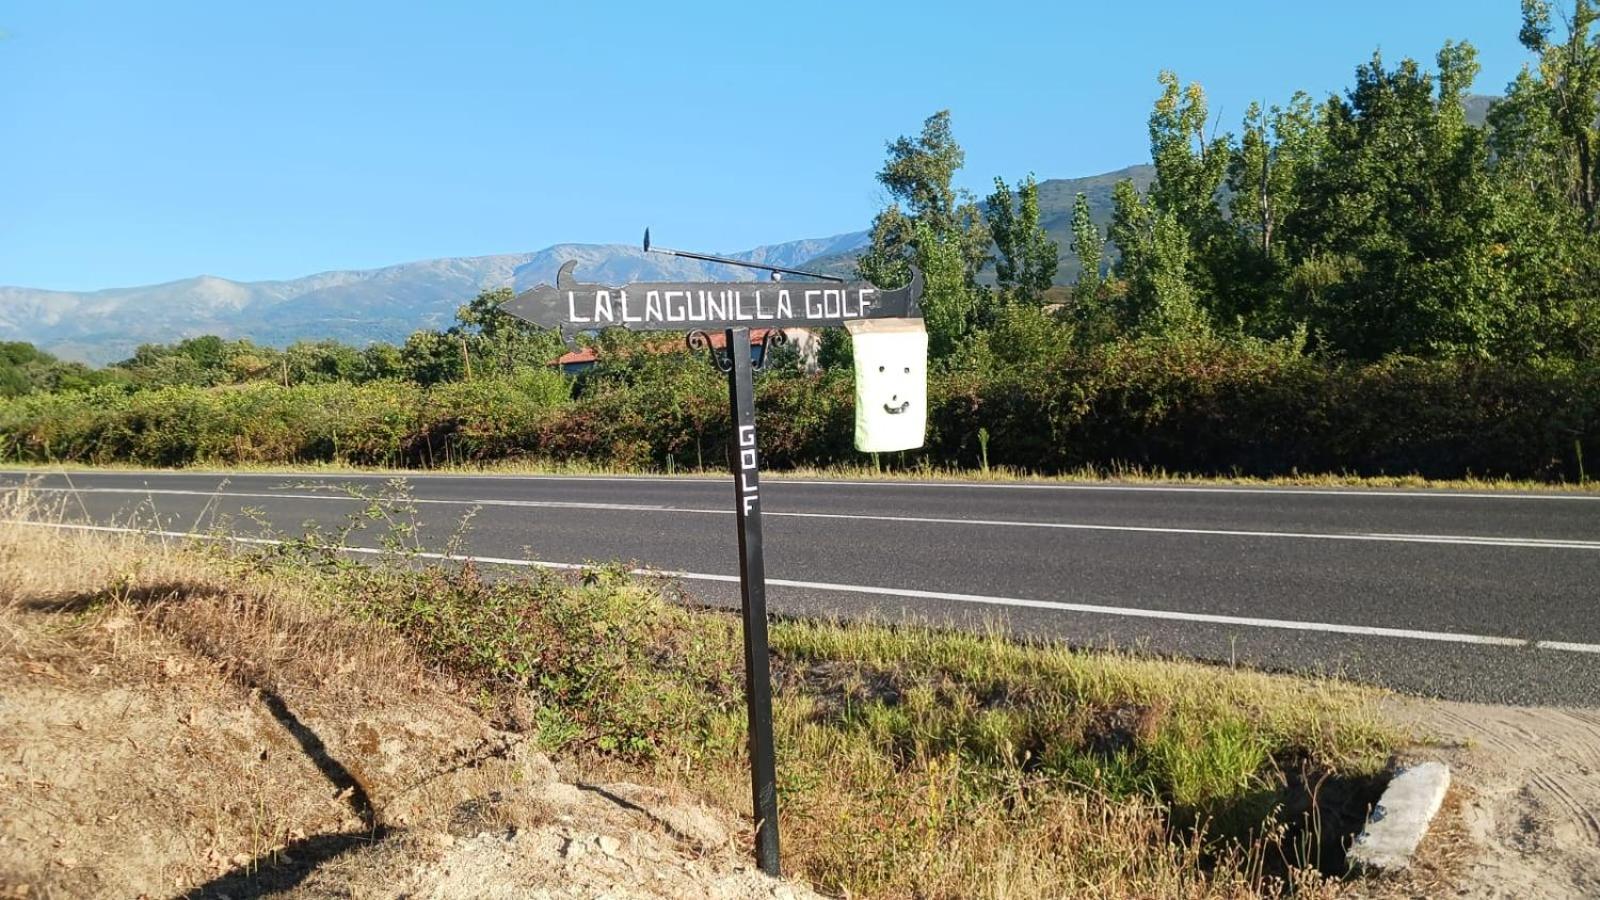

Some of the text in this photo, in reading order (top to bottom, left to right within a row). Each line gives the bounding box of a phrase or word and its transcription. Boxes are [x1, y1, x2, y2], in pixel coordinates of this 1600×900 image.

[568, 289, 875, 322] LA LAGUNILLA GOLF
[739, 425, 758, 517] GOLF
